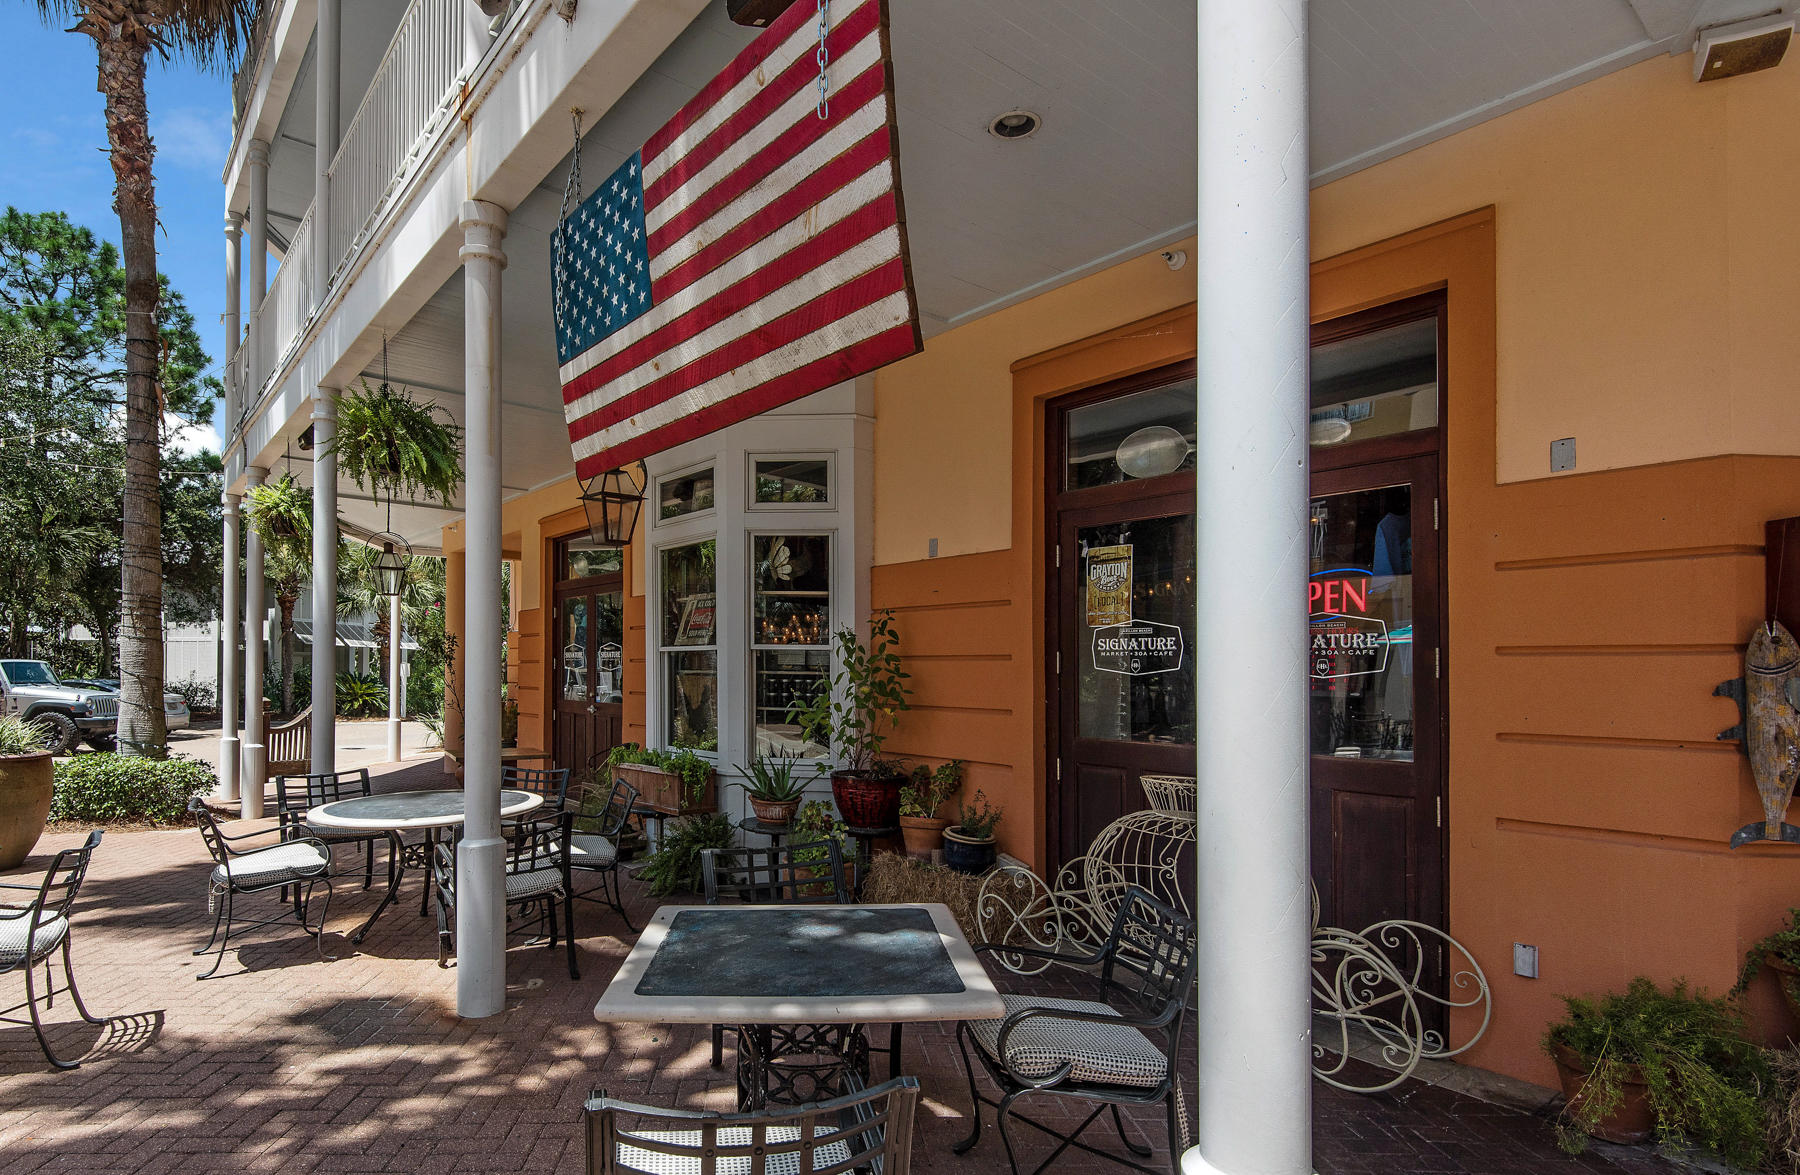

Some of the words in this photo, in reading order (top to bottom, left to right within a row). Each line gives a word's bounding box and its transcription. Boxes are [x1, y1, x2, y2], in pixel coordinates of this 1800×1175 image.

[1090, 562, 1127, 581] GRAYTON
[1309, 578, 1366, 613] PEN
[1097, 637, 1177, 650] SIGNATURE
[1311, 633, 1379, 648] ATURE
